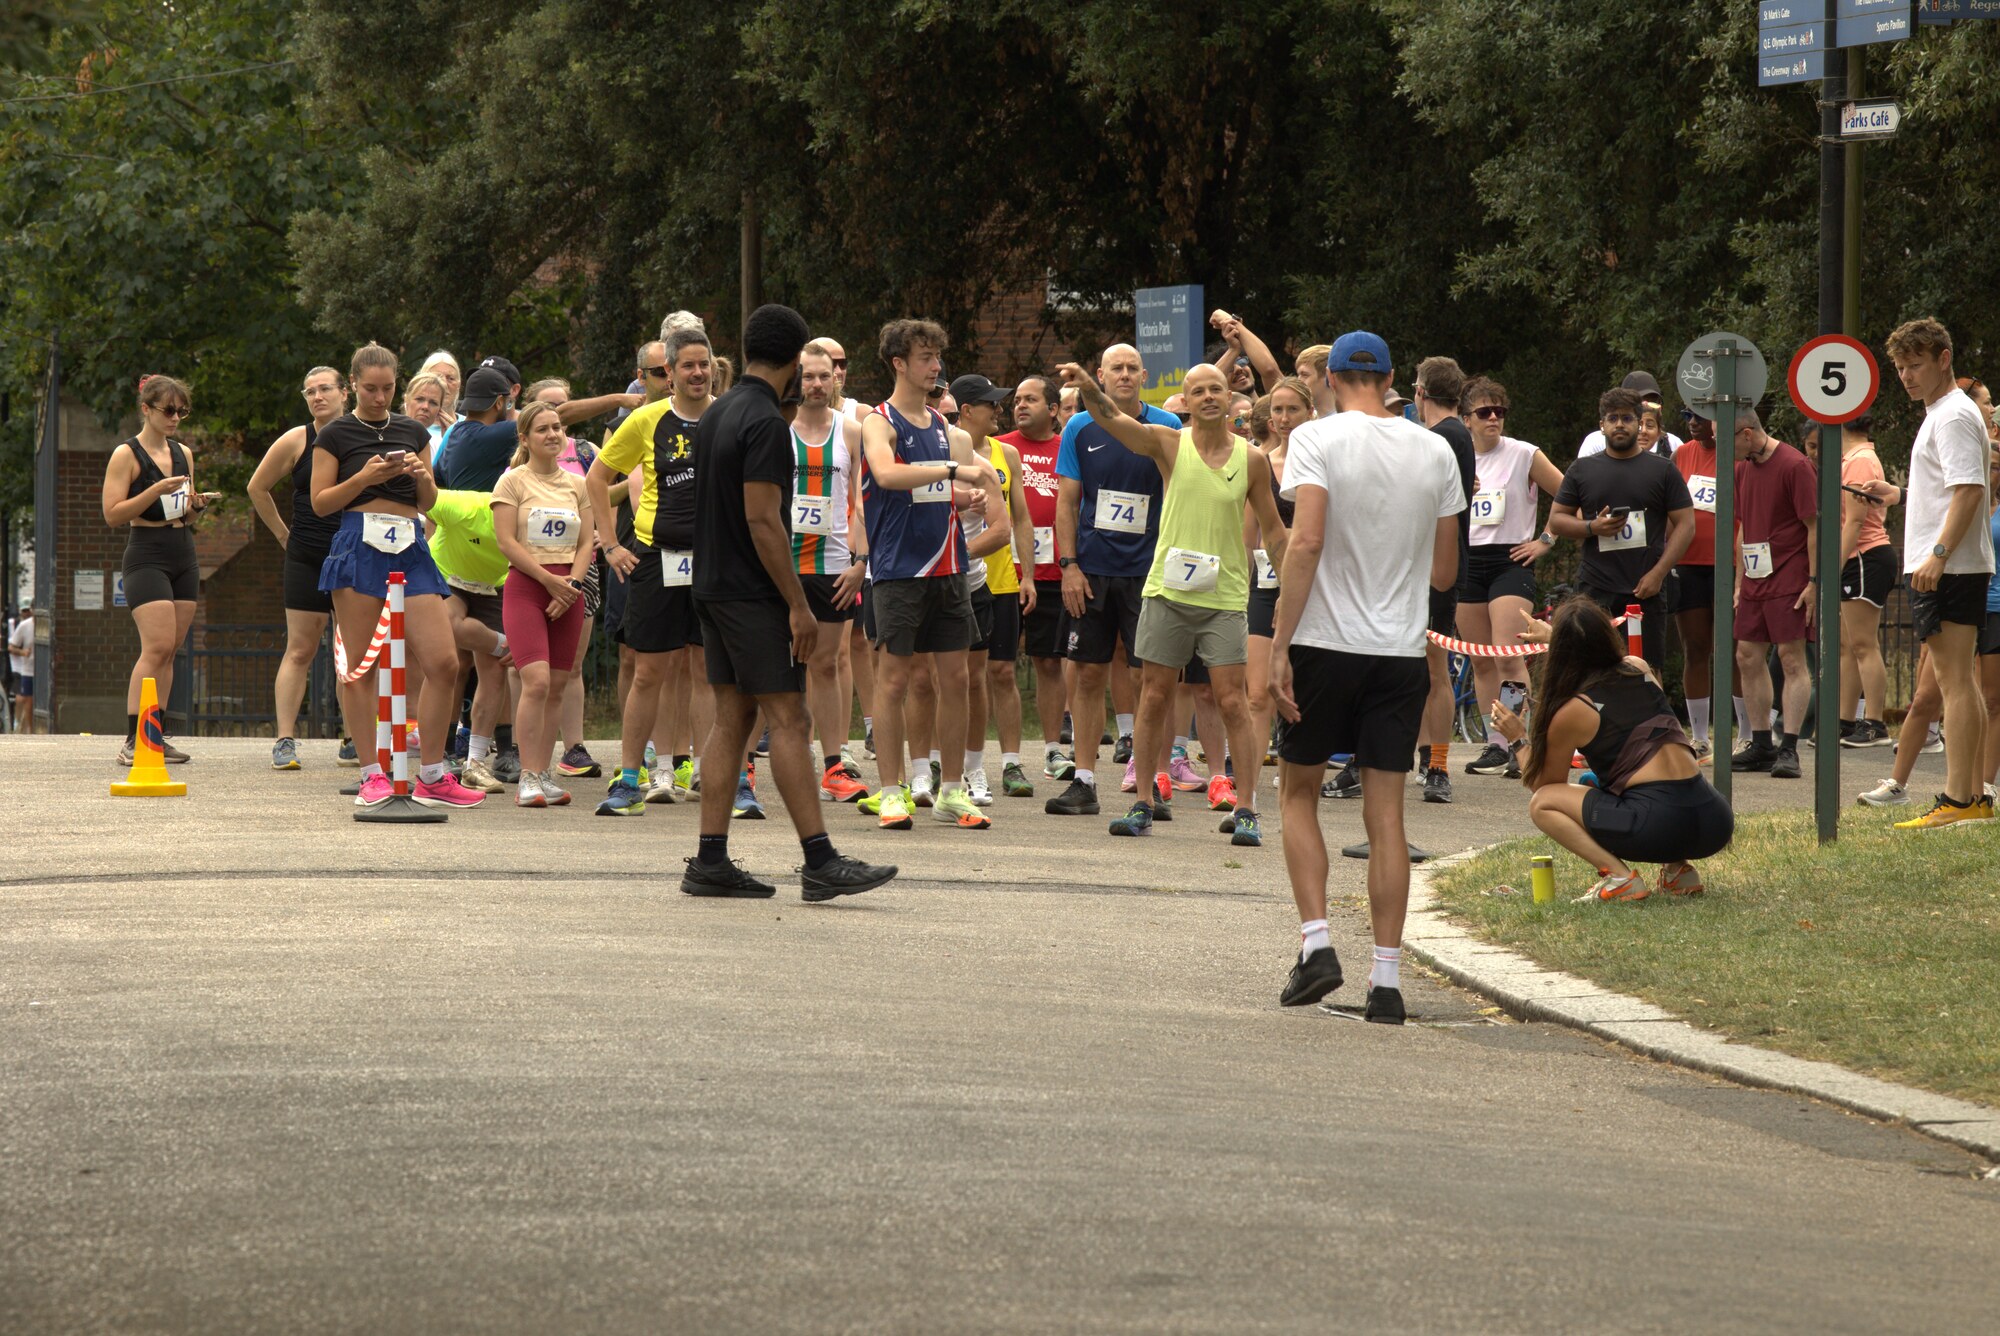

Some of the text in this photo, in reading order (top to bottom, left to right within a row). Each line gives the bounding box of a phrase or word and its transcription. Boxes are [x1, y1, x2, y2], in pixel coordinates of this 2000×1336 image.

[1781, 8, 1790, 18] Gate
[1877, 19, 1906, 34] Sports Pavilion
[1772, 36, 1788, 50] Olympic
[1788, 34, 1797, 45] Park
[1871, 110, 1889, 127] Café
[1139, 320, 1170, 337] Victoria Park
[1821, 361, 1846, 396] 5
[1022, 475, 1058, 484] ONDON
[1025, 470, 1051, 479] EAST
[1023, 481, 1059, 490] UNNERS
[1694, 487, 1716, 503] 43
[797, 507, 822, 525] 75
[1110, 503, 1134, 523] 74
[1472, 500, 1492, 517] 19
[384, 526, 397, 543] 4
[542, 520, 566, 537] 49
[1744, 554, 1758, 570] 17
[1184, 563, 1197, 581] 7
